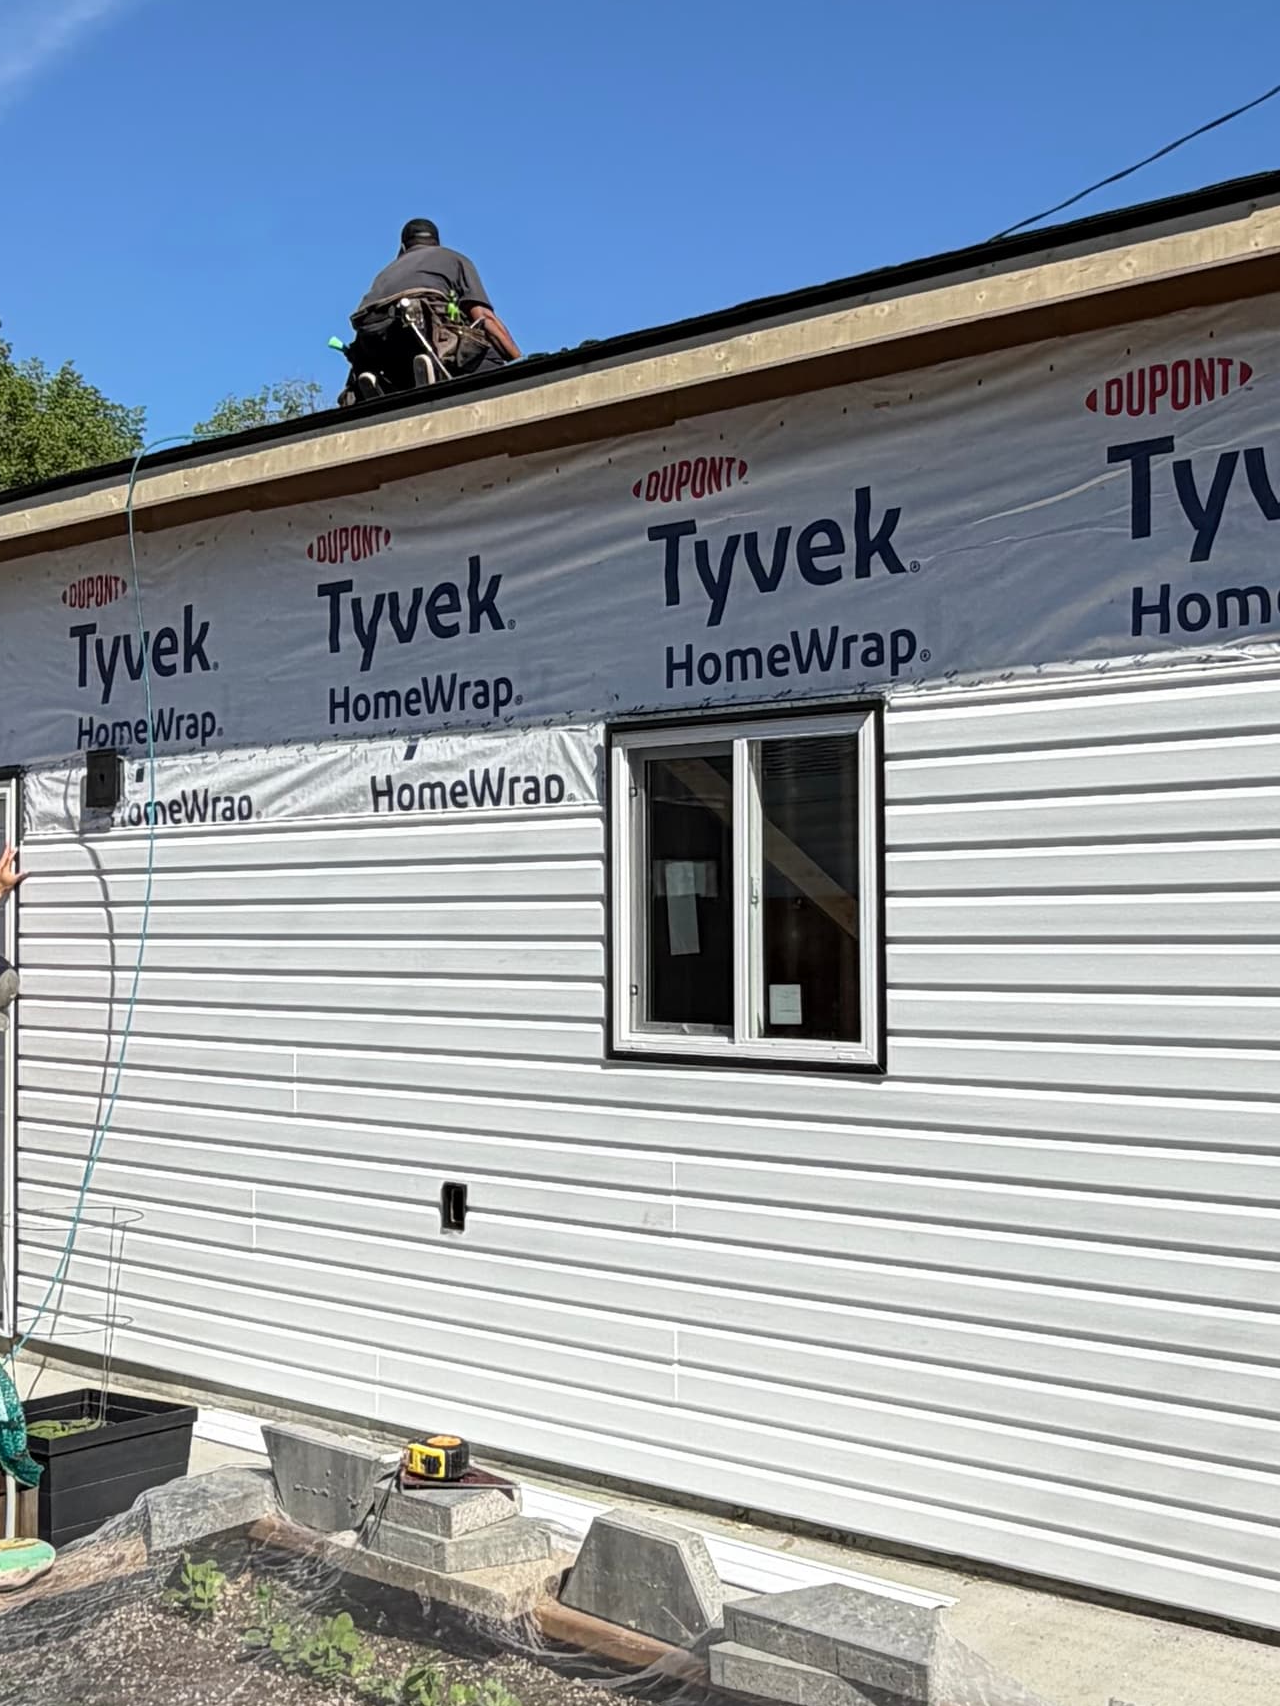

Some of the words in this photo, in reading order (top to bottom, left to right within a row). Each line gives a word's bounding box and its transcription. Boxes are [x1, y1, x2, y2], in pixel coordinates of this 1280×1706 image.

[1105, 358, 1234, 416] DUPONT
[646, 457, 736, 502] DUPONT
[317, 525, 383, 564] DUPONT
[647, 485, 907, 627] Tyvek
[70, 574, 120, 609] DUPONT
[317, 555, 506, 672] Tyvek
[69, 604, 212, 705] Tyvek
[666, 625, 917, 689] HomeWrap
[329, 673, 514, 724] HomeWrap
[77, 707, 217, 750] HomeWrap
[120, 787, 253, 827] omeWrap
